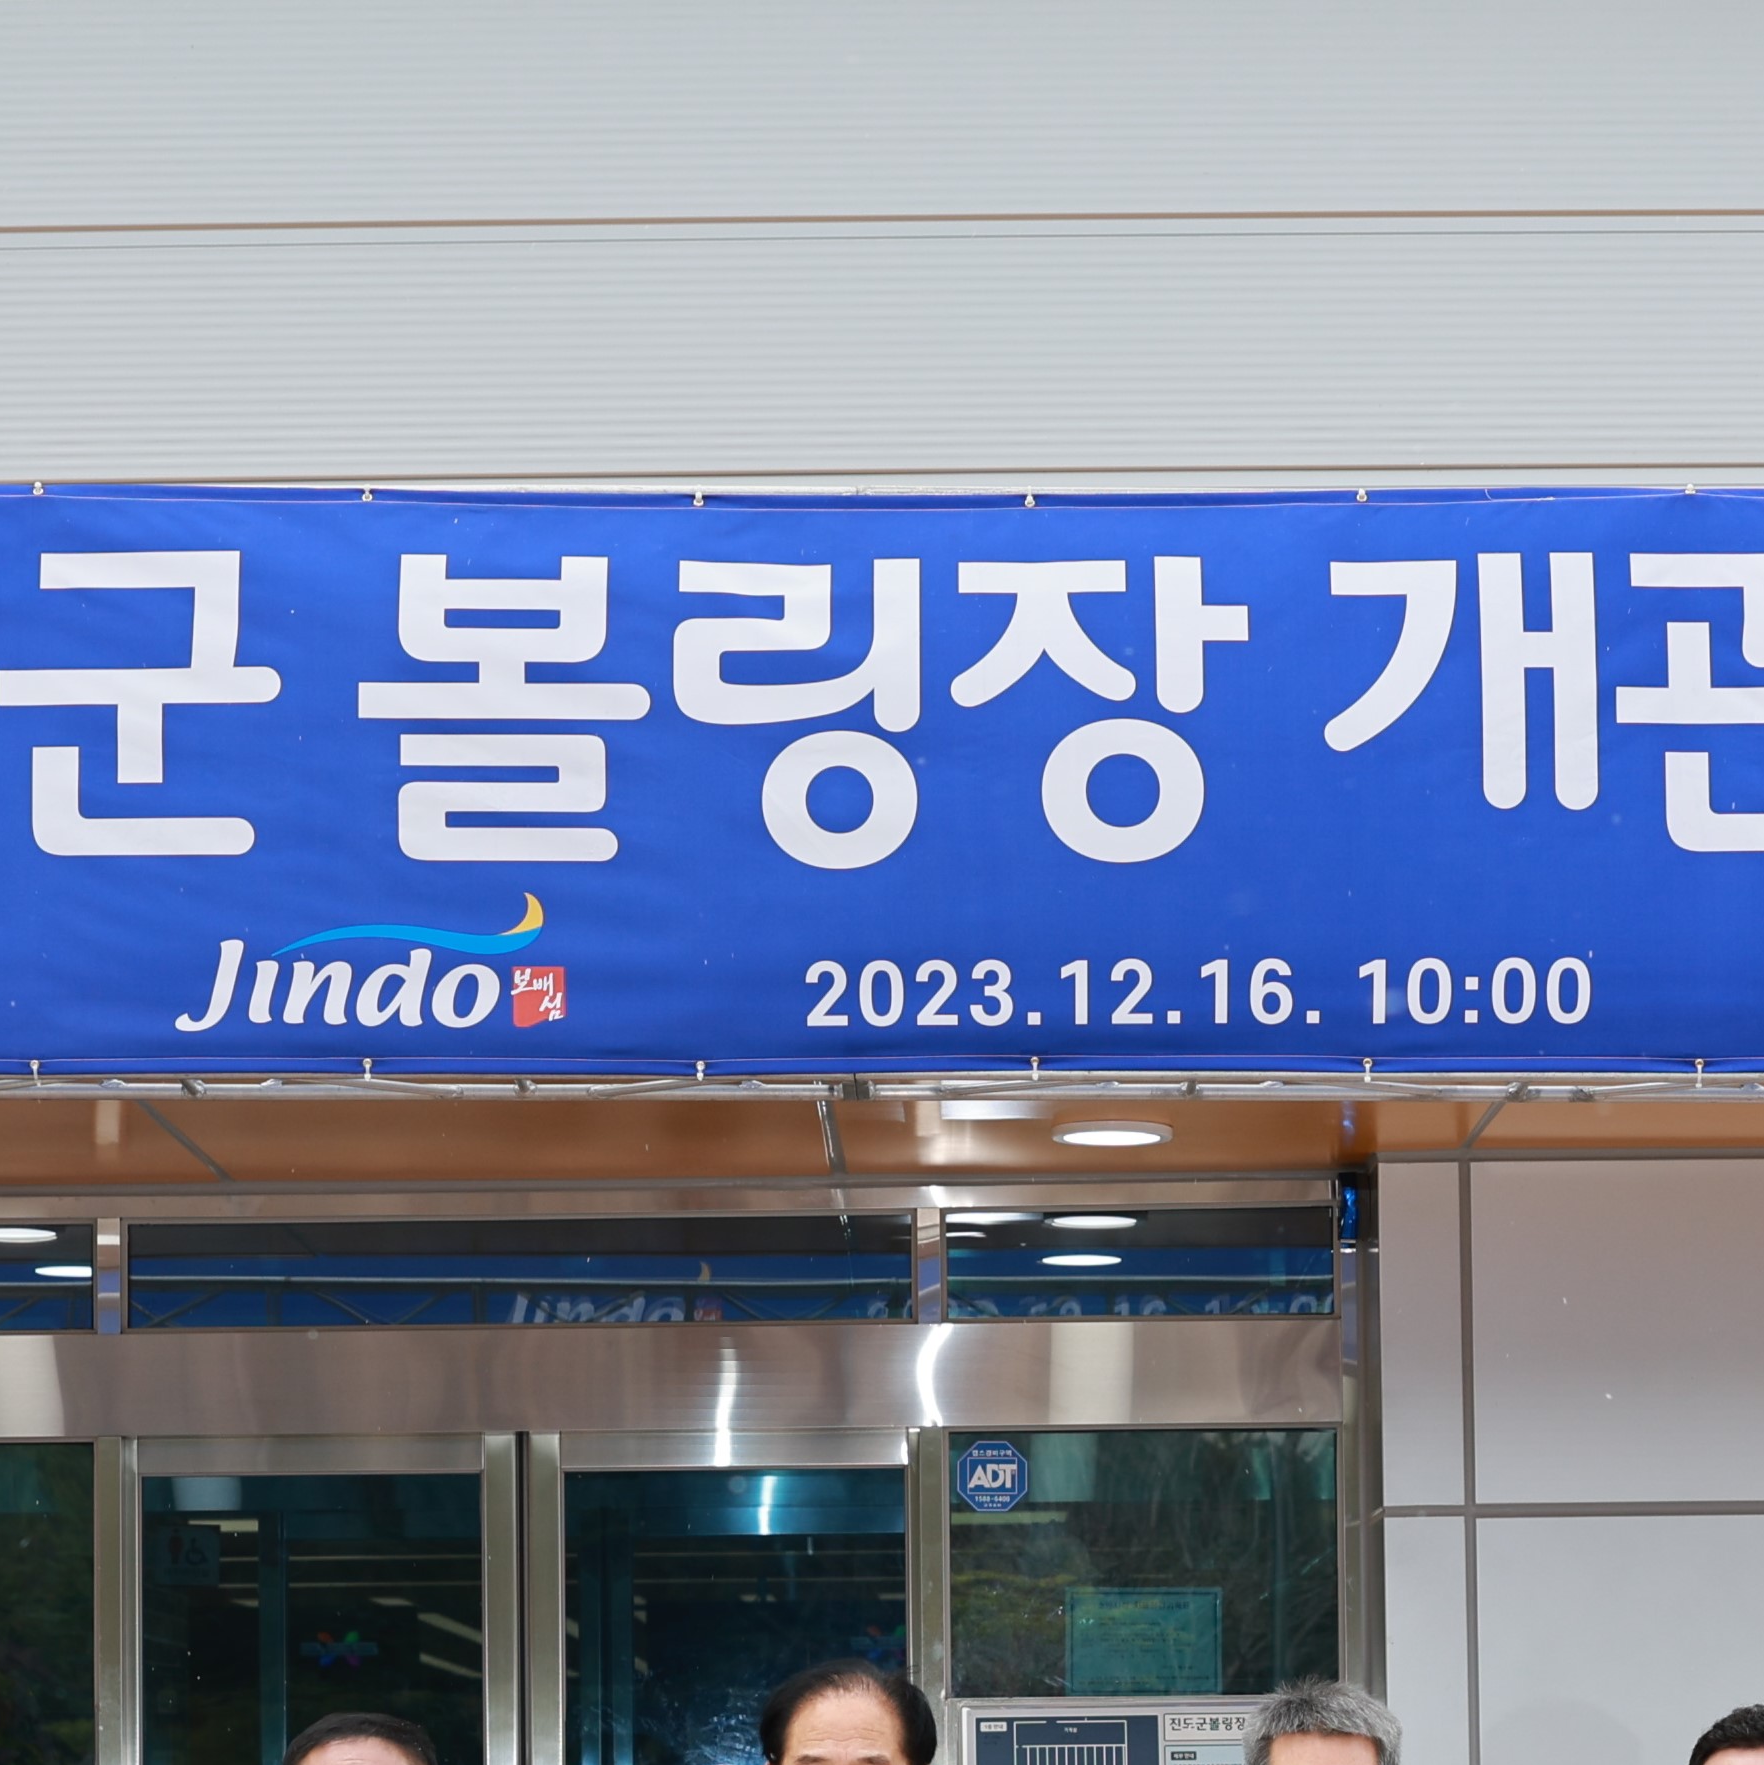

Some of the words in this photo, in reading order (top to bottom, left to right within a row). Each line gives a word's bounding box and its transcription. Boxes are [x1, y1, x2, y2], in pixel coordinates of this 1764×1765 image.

[358, 553, 1248, 870] 볼링장
[174, 939, 500, 1032] Jindo
[805, 957, 1320, 1027] 2023.12.16.
[1359, 957, 1591, 1025] 10:00
[968, 1463, 1017, 1489] ADT
